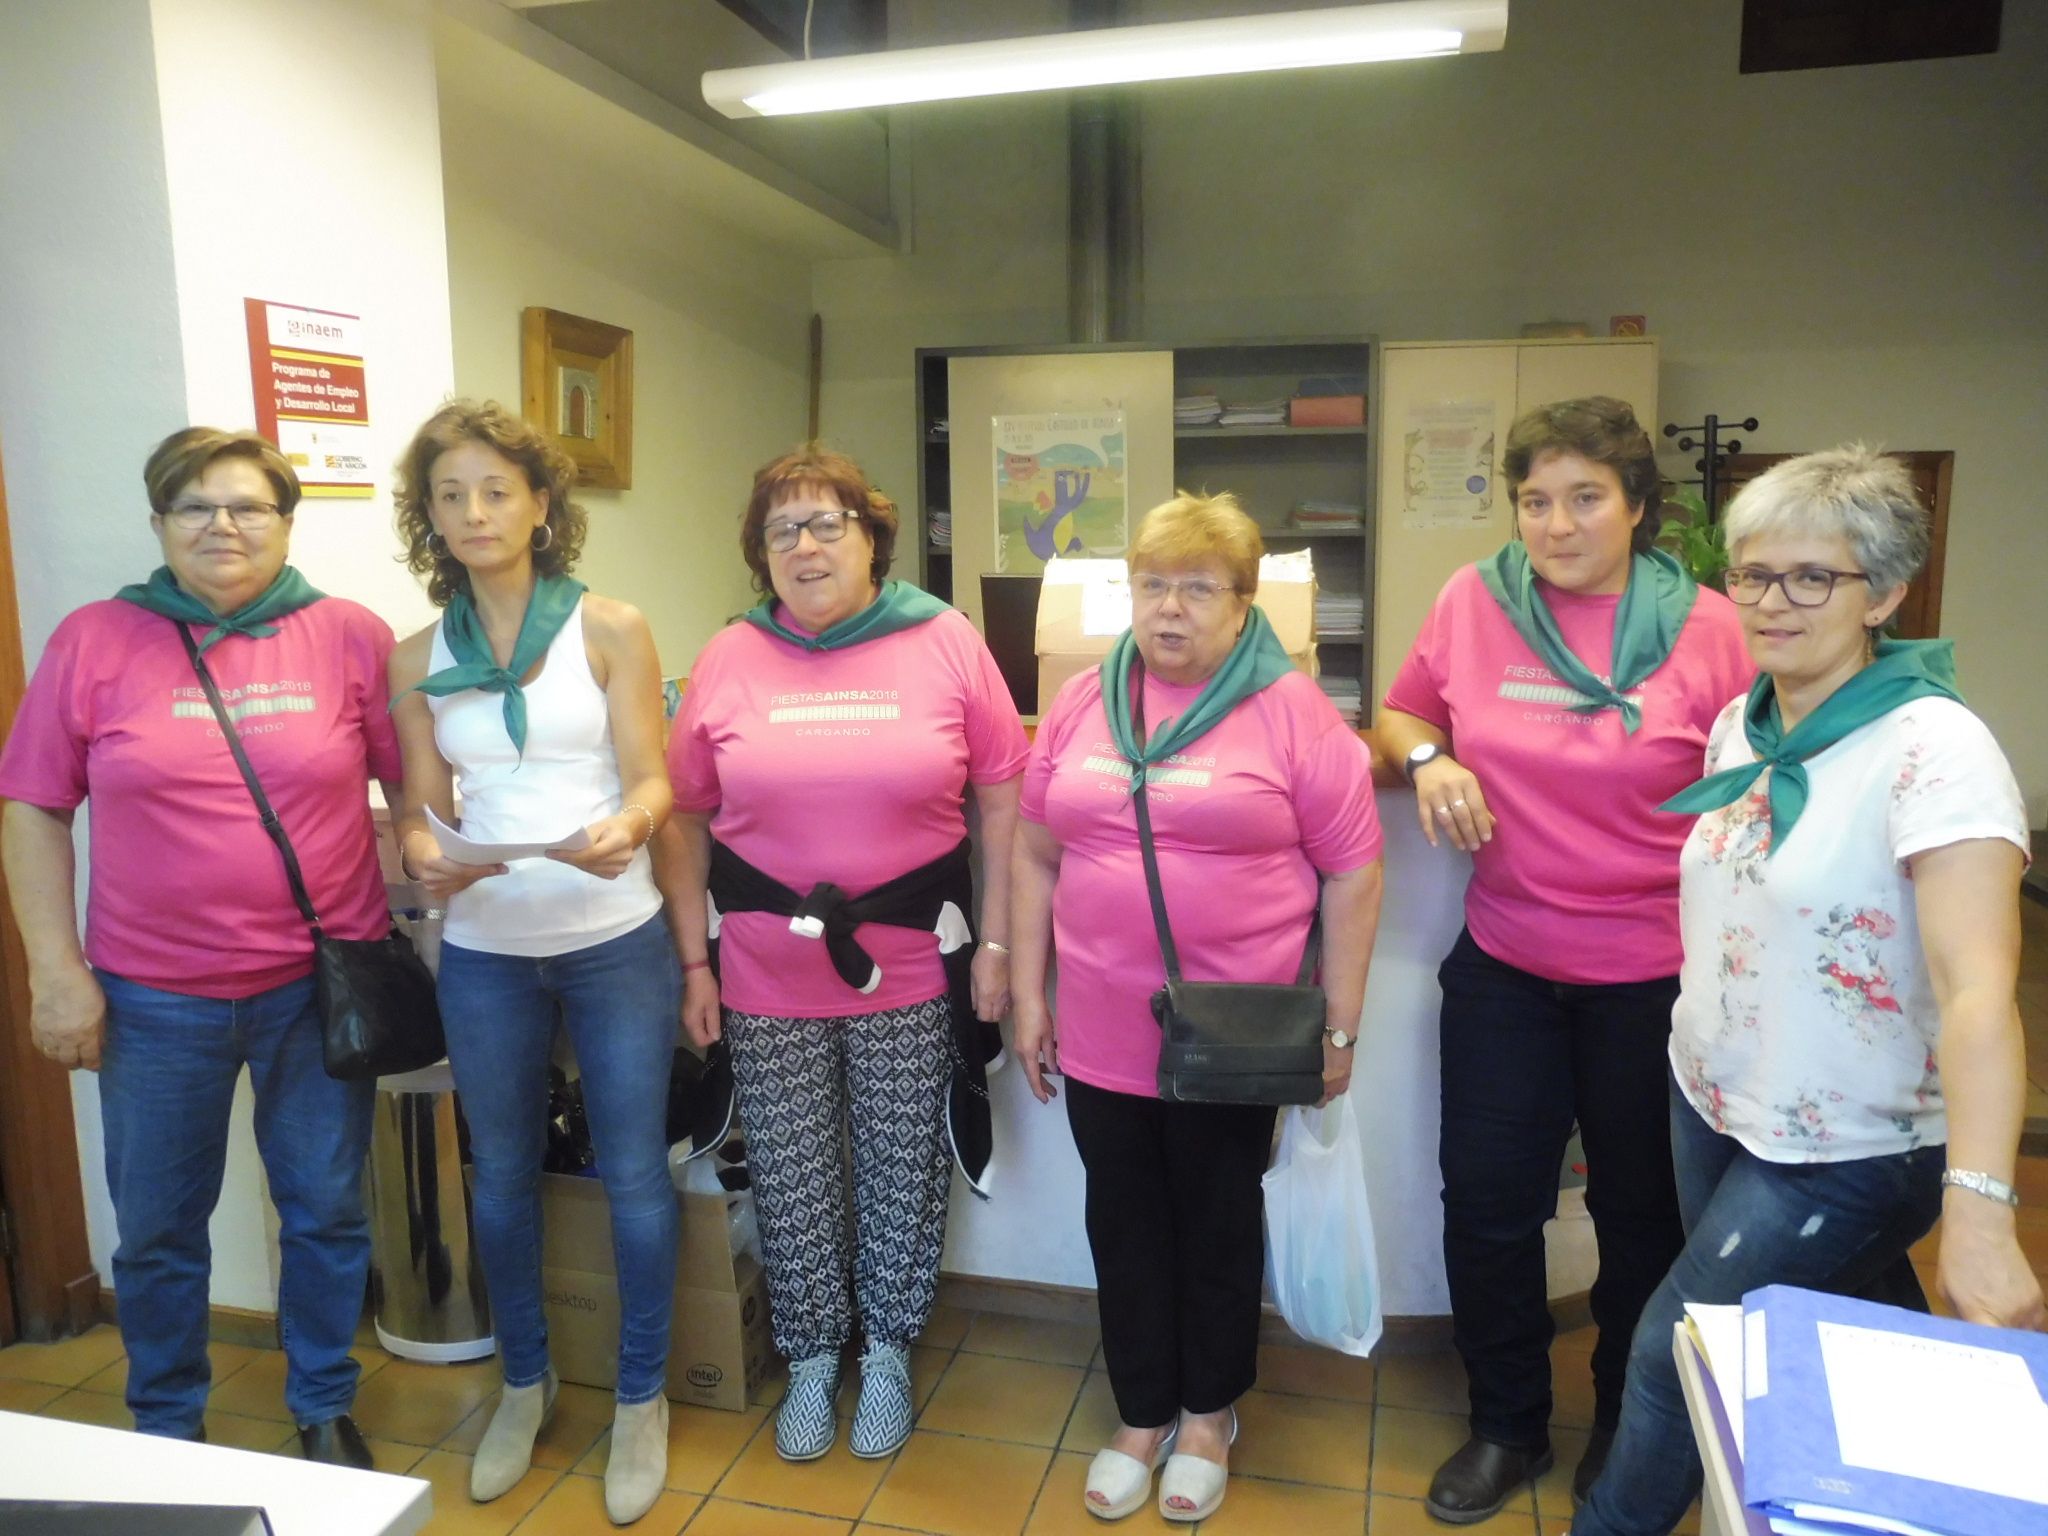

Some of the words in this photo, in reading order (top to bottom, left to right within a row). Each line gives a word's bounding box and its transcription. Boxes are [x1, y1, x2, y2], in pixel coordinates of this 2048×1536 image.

[302, 321, 343, 339] inaem
[272, 362, 317, 377] Programa
[318, 367, 331, 379] de
[273, 379, 313, 394] Agentes
[313, 383, 326, 395] de
[326, 384, 359, 399] Empleo
[275, 398, 282, 410] y
[283, 397, 330, 411] Desarrollo
[331, 400, 356, 414] Local
[1522, 711, 1604, 726] CARGANDO
[206, 721, 285, 738] CAANDO
[795, 728, 871, 737] CARGANDO
